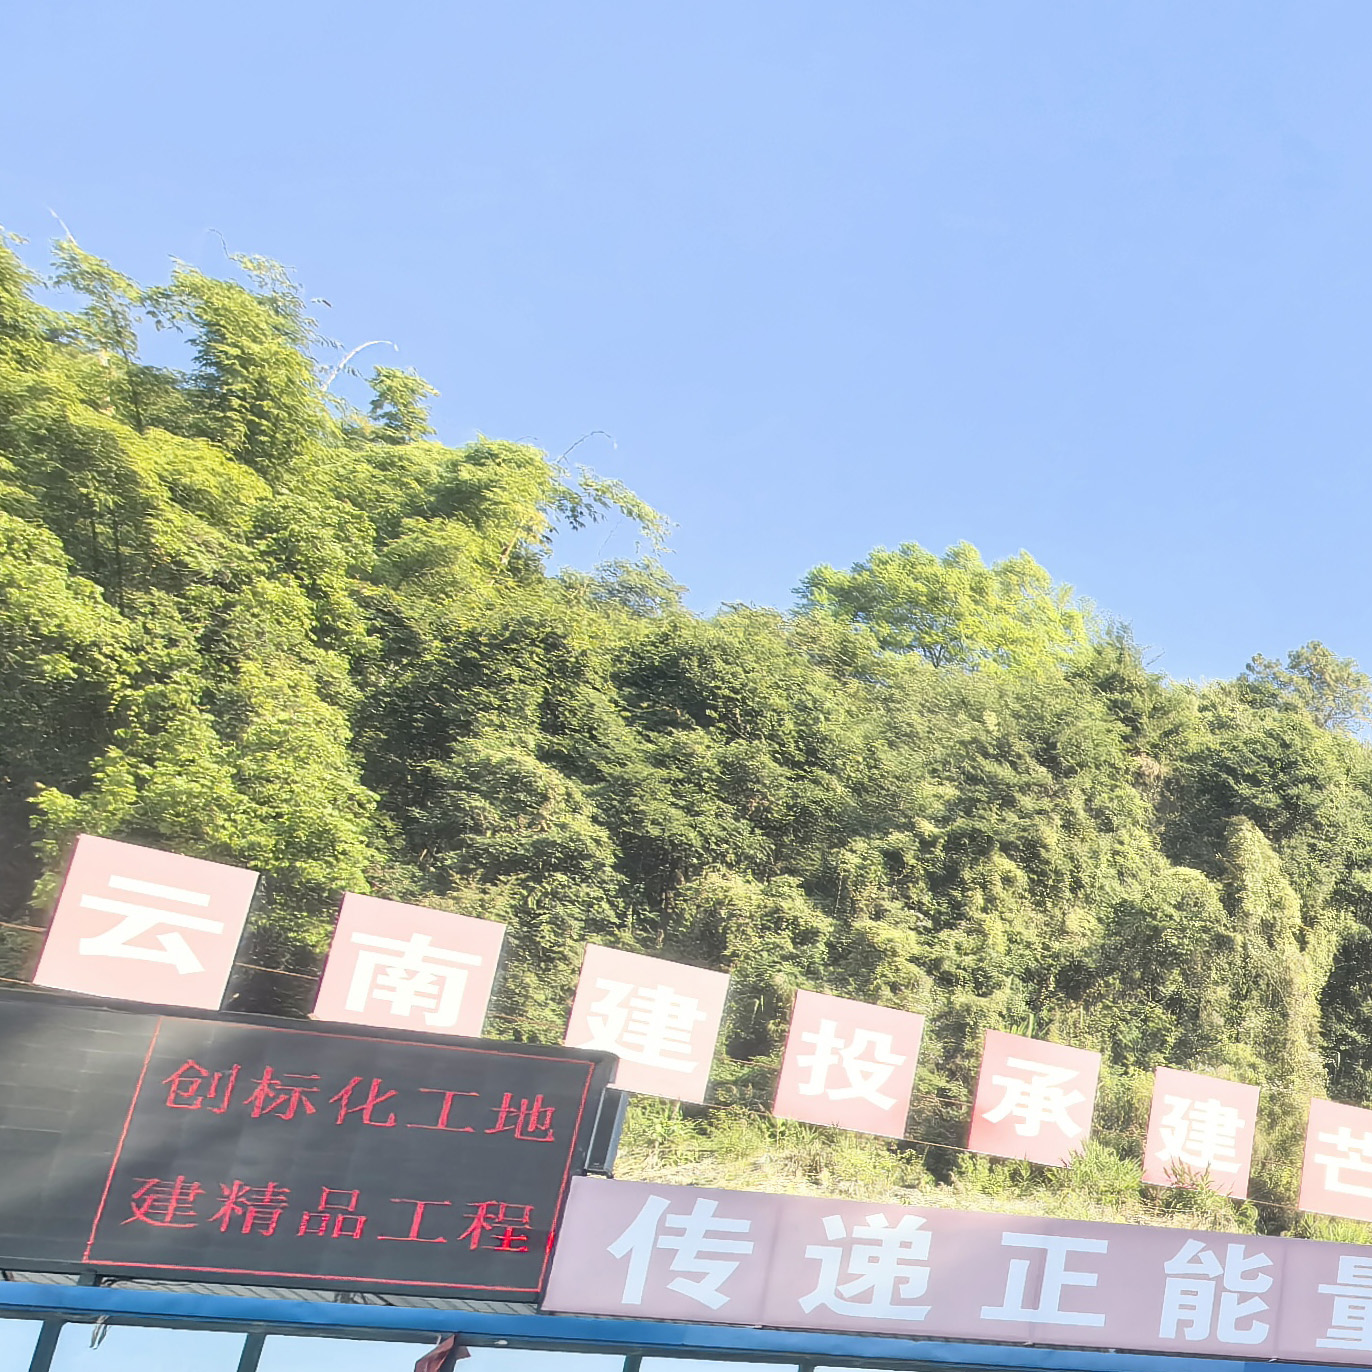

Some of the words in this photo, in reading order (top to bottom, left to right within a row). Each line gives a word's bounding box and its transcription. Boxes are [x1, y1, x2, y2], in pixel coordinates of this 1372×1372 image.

[162, 1058, 555, 1142] 创标化工地
[120, 1174, 535, 1253] 建精品工程
